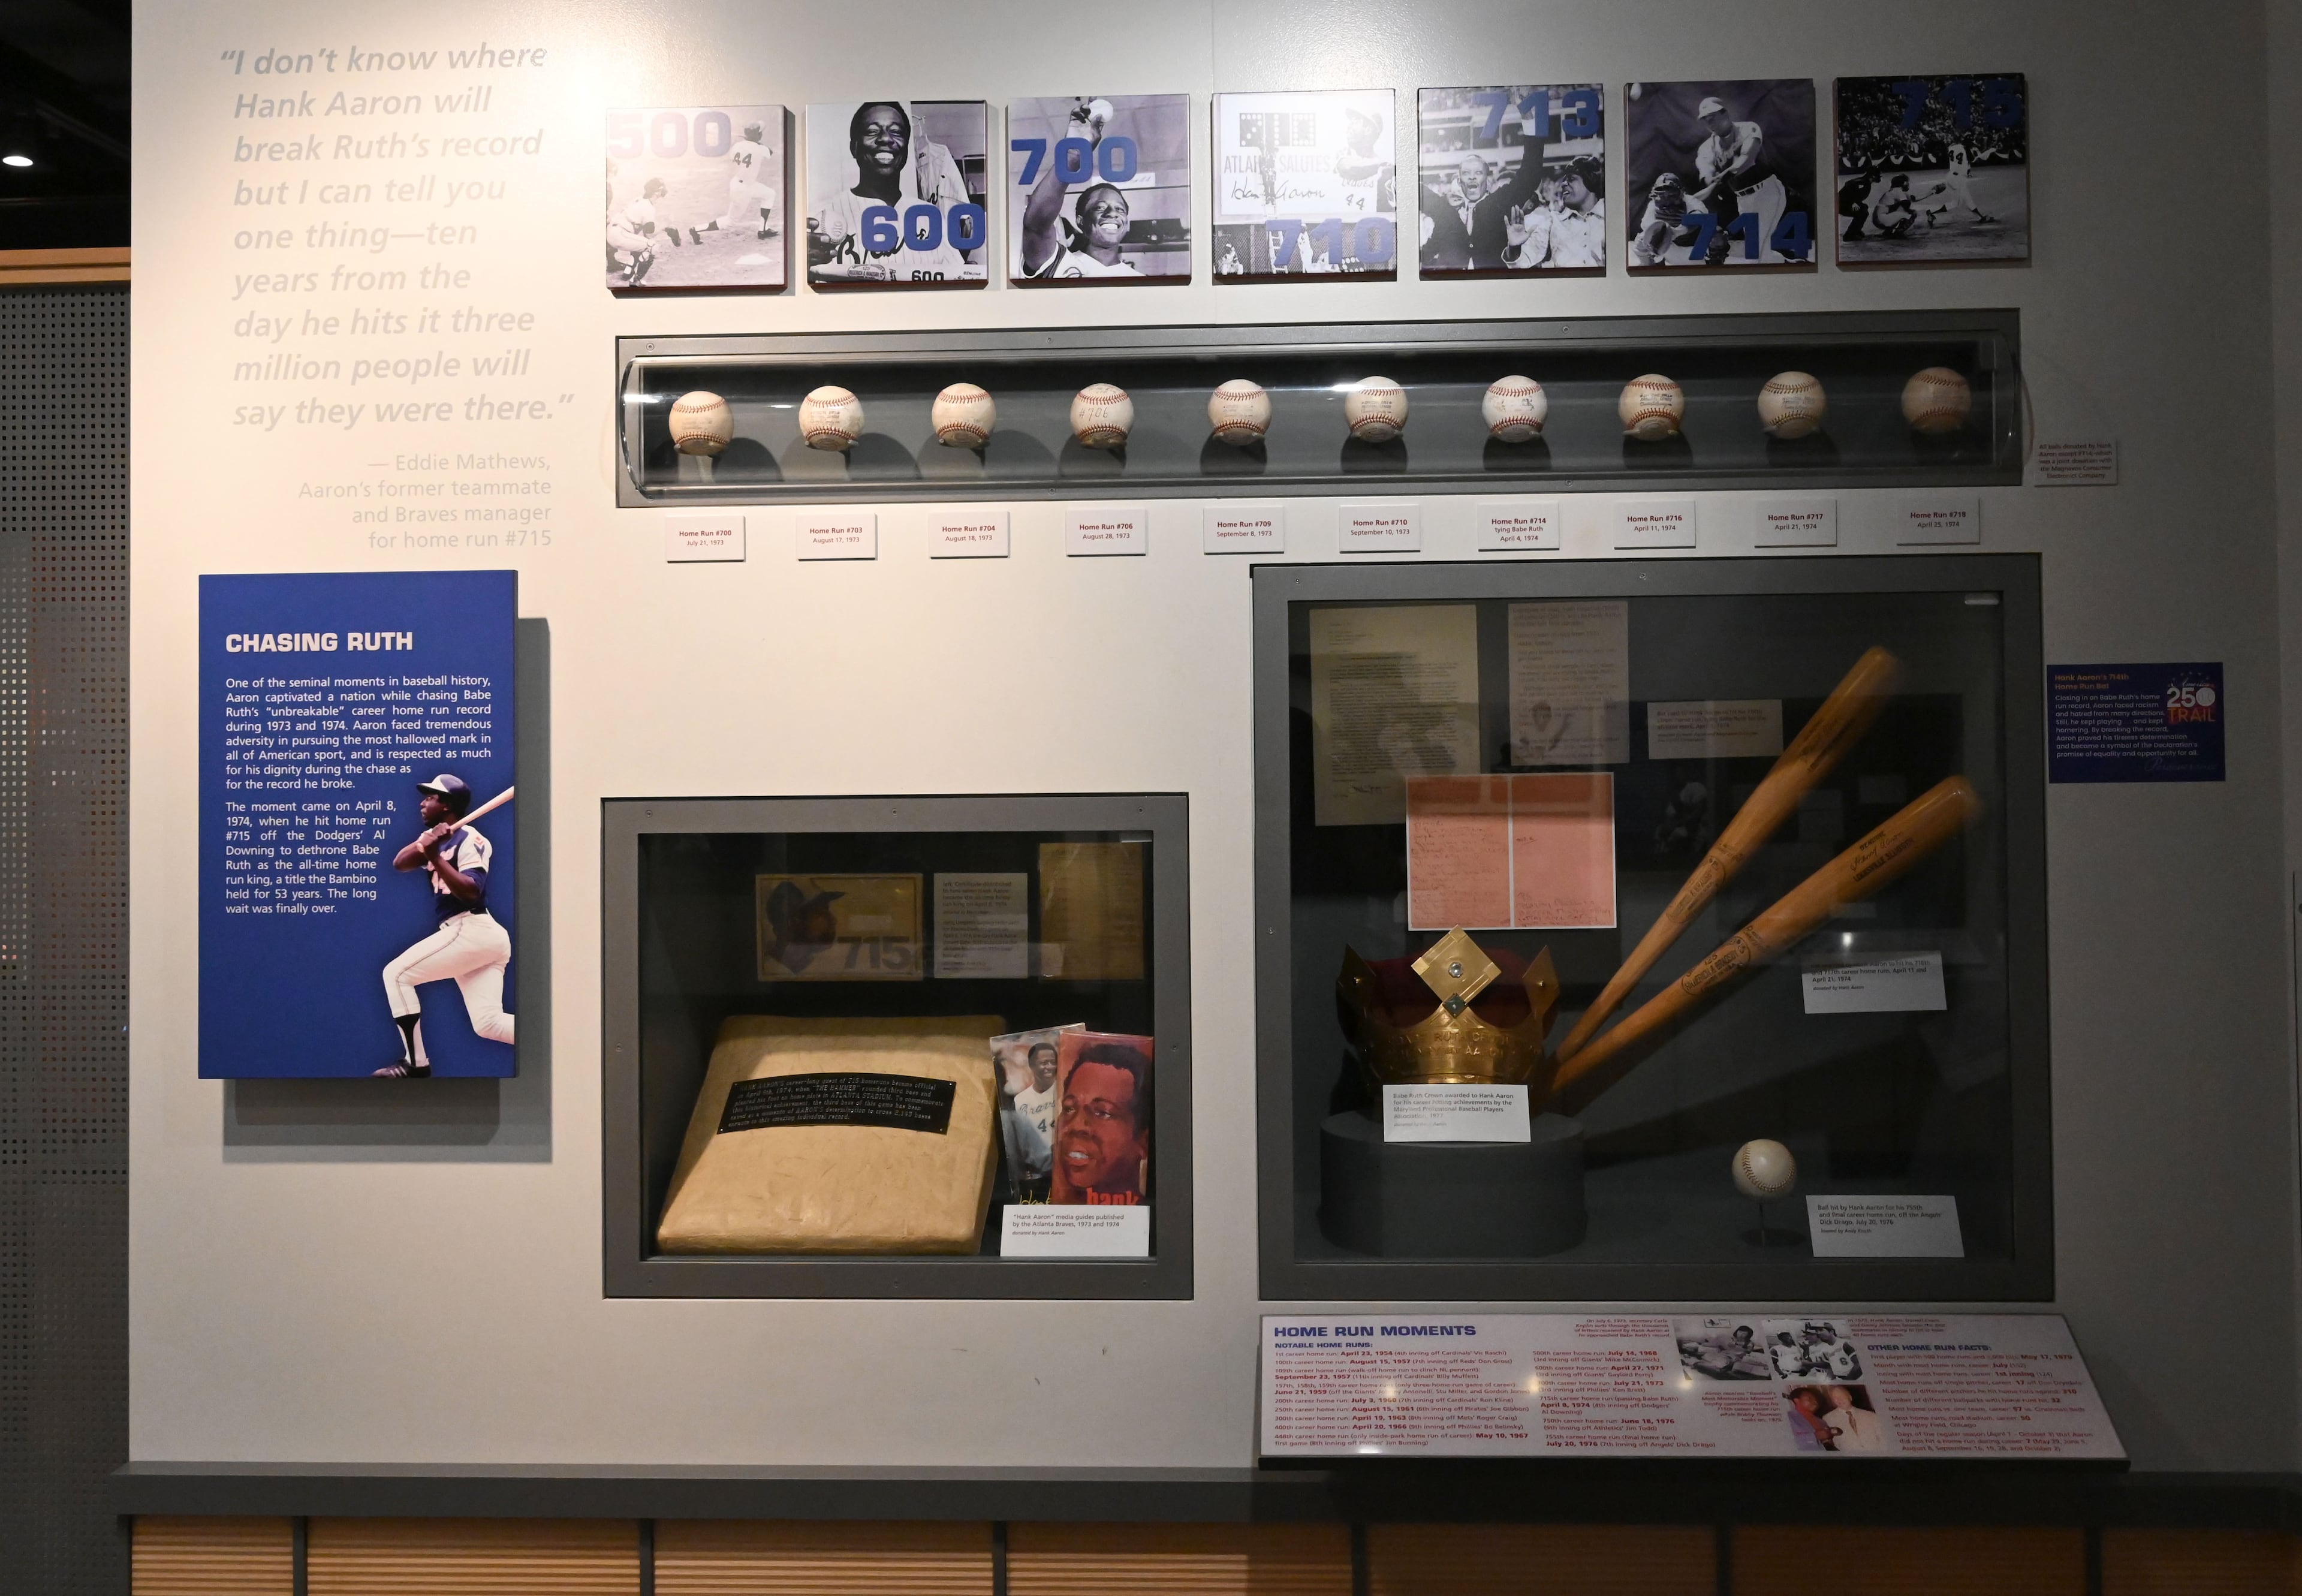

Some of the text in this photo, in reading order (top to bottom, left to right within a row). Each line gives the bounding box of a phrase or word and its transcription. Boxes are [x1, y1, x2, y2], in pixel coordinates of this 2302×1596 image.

[220, 41, 547, 75] “I don’t know where
[234, 86, 492, 119] Hank Aaron will
[1891, 80, 2023, 128] 715
[1473, 89, 1601, 138] 713
[608, 110, 731, 158] 500
[234, 128, 543, 162] break Ruth’s record
[734, 152, 752, 168] 44
[1011, 136, 1137, 185] 700
[1279, 155, 1330, 173] SALUTES
[861, 203, 986, 252] 600
[1681, 211, 1812, 260] 714
[1266, 216, 1394, 266] 710
[233, 393, 576, 432] say they were there.”
[1079, 407, 1108, 421] #706
[396, 452, 550, 471] Eddie Mathews,
[299, 479, 552, 498] Aaron’s former teammate
[1082, 533, 1104, 541] August
[1774, 523, 1790, 532] April
[368, 529, 552, 549] for home run #715
[1499, 535, 1515, 543] April
[226, 631, 412, 652] CHASING RUTH
[225, 675, 490, 688] One of the seminal moments in baseball history,
[2054, 694, 2080, 703] Closing
[226, 704, 491, 717] Ruth’s “unbreakable” career home run record
[2167, 708, 2216, 722] TRAIL
[225, 800, 396, 813] The moment came on April 8,
[226, 829, 385, 842] #715 off the Dodgers’ Al
[842, 935, 912, 970] 715
[1074, 1213, 1095, 1221] guides
[1274, 1326, 1476, 1337] HOME RUN MOMENTS
